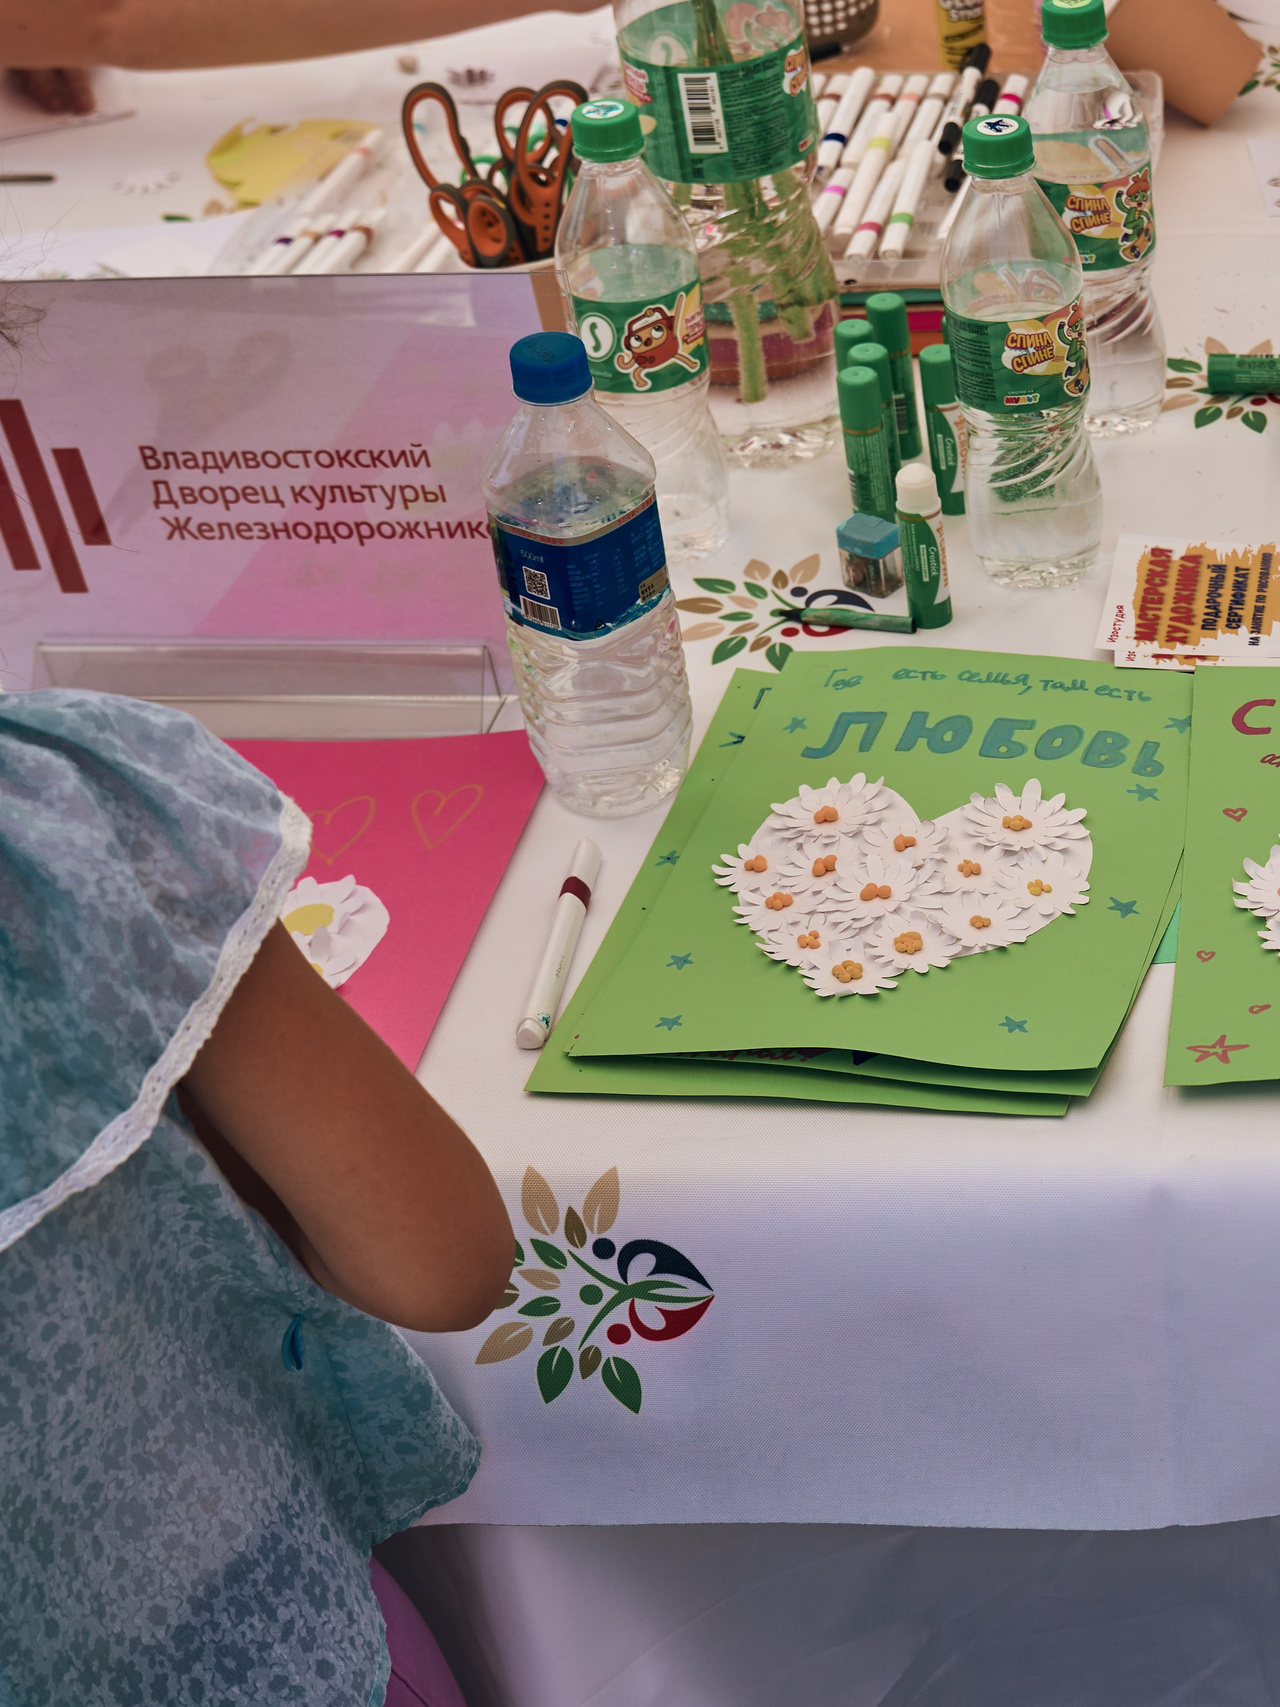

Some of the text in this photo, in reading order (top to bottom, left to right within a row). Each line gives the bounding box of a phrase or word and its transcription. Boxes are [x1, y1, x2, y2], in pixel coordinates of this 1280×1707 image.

[1065, 195, 1111, 212] СПИНА
[1070, 213, 1111, 233] СПИНЕ
[1006, 332, 1054, 350] СПИНА
[1012, 346, 1055, 373] СПИНЕ
[138, 443, 432, 475] Владивостокский
[152, 480, 448, 511] Дворец культуры
[519, 549, 545, 564] 500ml
[928, 546, 940, 577] Crostick
[1133, 547, 1173, 642] МАСТЕРСКАЯ
[1165, 554, 1204, 645] ХУДОЖНИКА
[1201, 564, 1227, 631] ПОДАРОЧНЫЙ
[1226, 566, 1251, 630] СЕРТИФИКАТ
[1248, 552, 1273, 646] НА ЗАНЯТИЕ ПО РИСОВАНИЮ
[1106, 605, 1125, 643] Изостудия
[824, 667, 1153, 703] Где есть семья, там есть
[800, 709, 1166, 778] ЛЮБОВЬ
